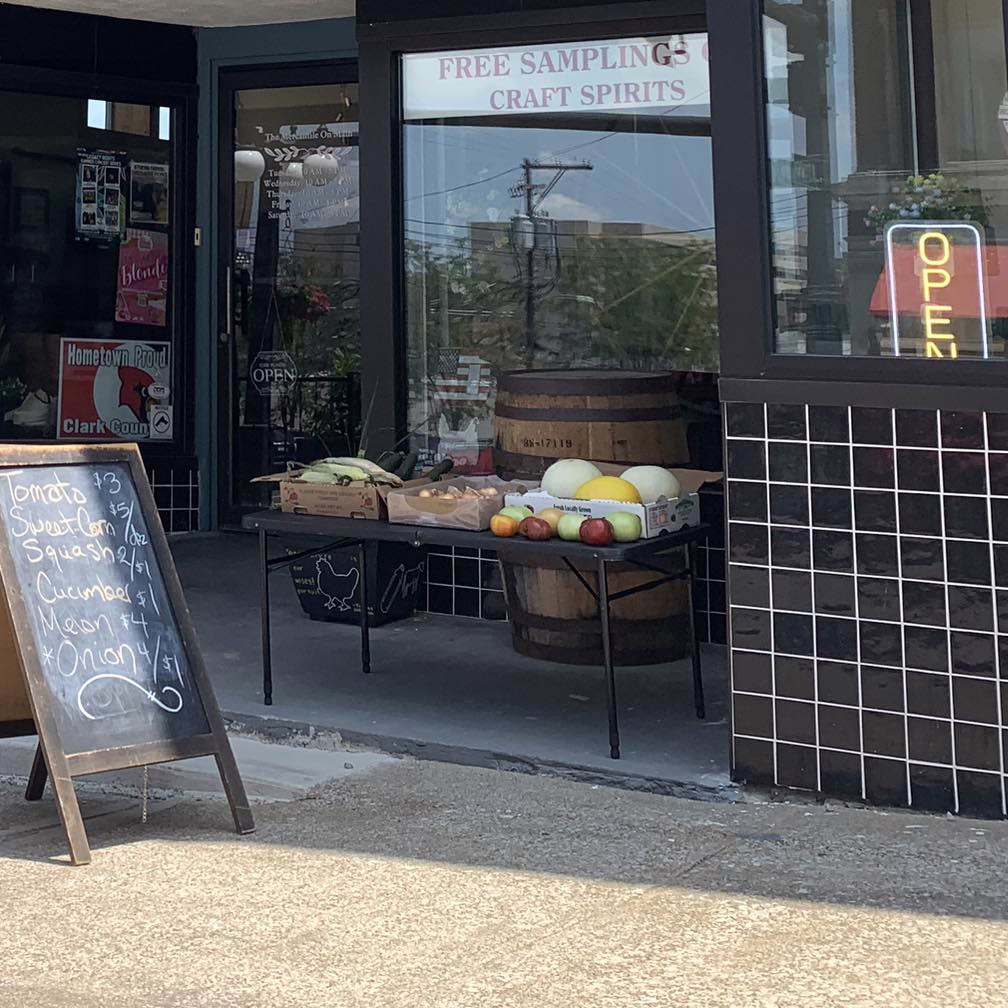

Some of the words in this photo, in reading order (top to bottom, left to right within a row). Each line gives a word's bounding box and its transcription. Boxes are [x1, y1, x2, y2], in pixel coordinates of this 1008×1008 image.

[438, 53, 511, 81] FREE
[520, 41, 691, 76] SAMPLINGS
[490, 86, 572, 111] CRAFT
[580, 78, 687, 106] SPIRITS
[320, 130, 332, 140] On
[918, 232, 957, 360] OPEN
[67, 343, 130, 367] Hometown
[135, 345, 167, 369] Proud
[253, 368, 294, 383] OPEN
[63, 418, 107, 435] Clark
[110, 418, 148, 435] Coun
[94, 471, 121, 494] $3
[22, 539, 116, 574] Squash
[37, 571, 132, 604] Cucumber
[137, 583, 160, 615] $1
[38, 606, 113, 640] Melon
[120, 613, 149, 639] $4
